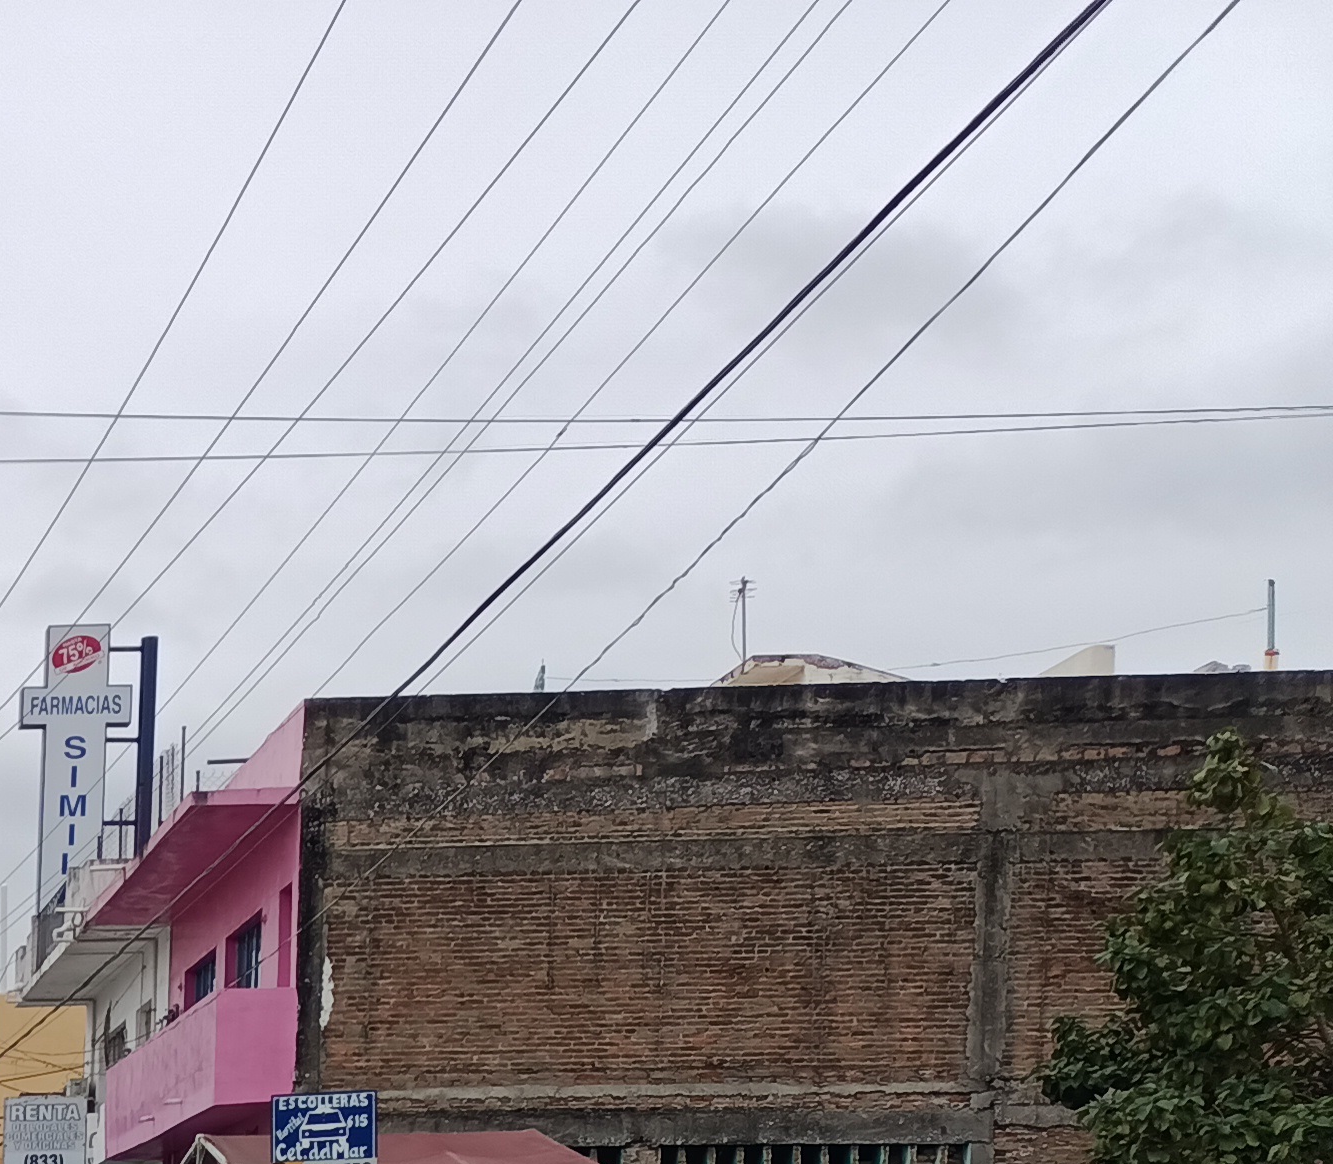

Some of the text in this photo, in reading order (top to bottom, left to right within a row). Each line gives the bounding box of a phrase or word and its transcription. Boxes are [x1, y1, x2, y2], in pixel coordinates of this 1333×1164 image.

[58, 639, 93, 665] 75%
[30, 694, 122, 716] FARMACIAS
[278, 1092, 369, 1111] ESCOLLERAS
[10, 1103, 81, 1122] RENTA
